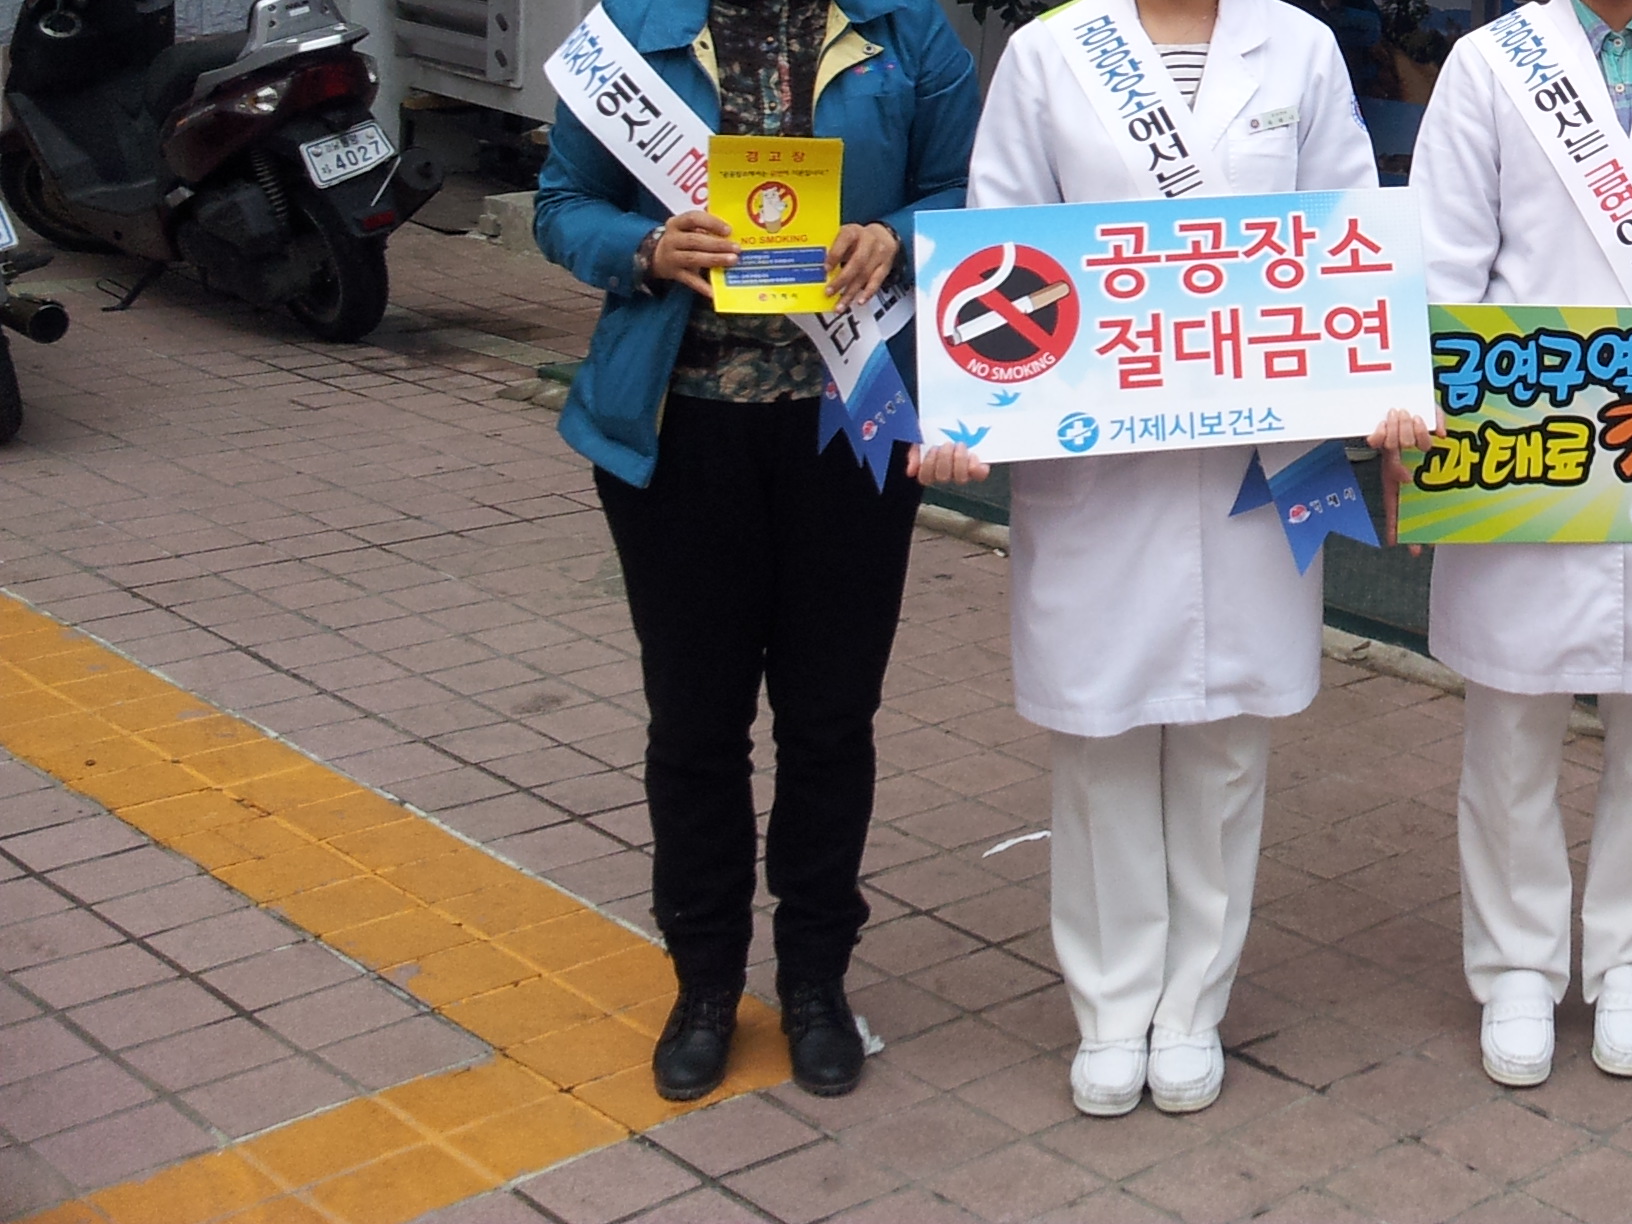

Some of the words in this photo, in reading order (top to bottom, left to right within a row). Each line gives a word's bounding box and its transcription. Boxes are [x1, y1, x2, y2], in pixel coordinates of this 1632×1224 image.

[341, 140, 385, 169] 4027
[740, 236, 756, 245] NO
[759, 234, 809, 245] SMOKING
[1085, 213, 1395, 300] 공공장소
[1095, 298, 1393, 390] 절대금연
[966, 356, 992, 379] NO
[991, 351, 1057, 381] SMOKING
[1109, 407, 1286, 445] 거제시보건소
[1420, 421, 1591, 485] 과태료
